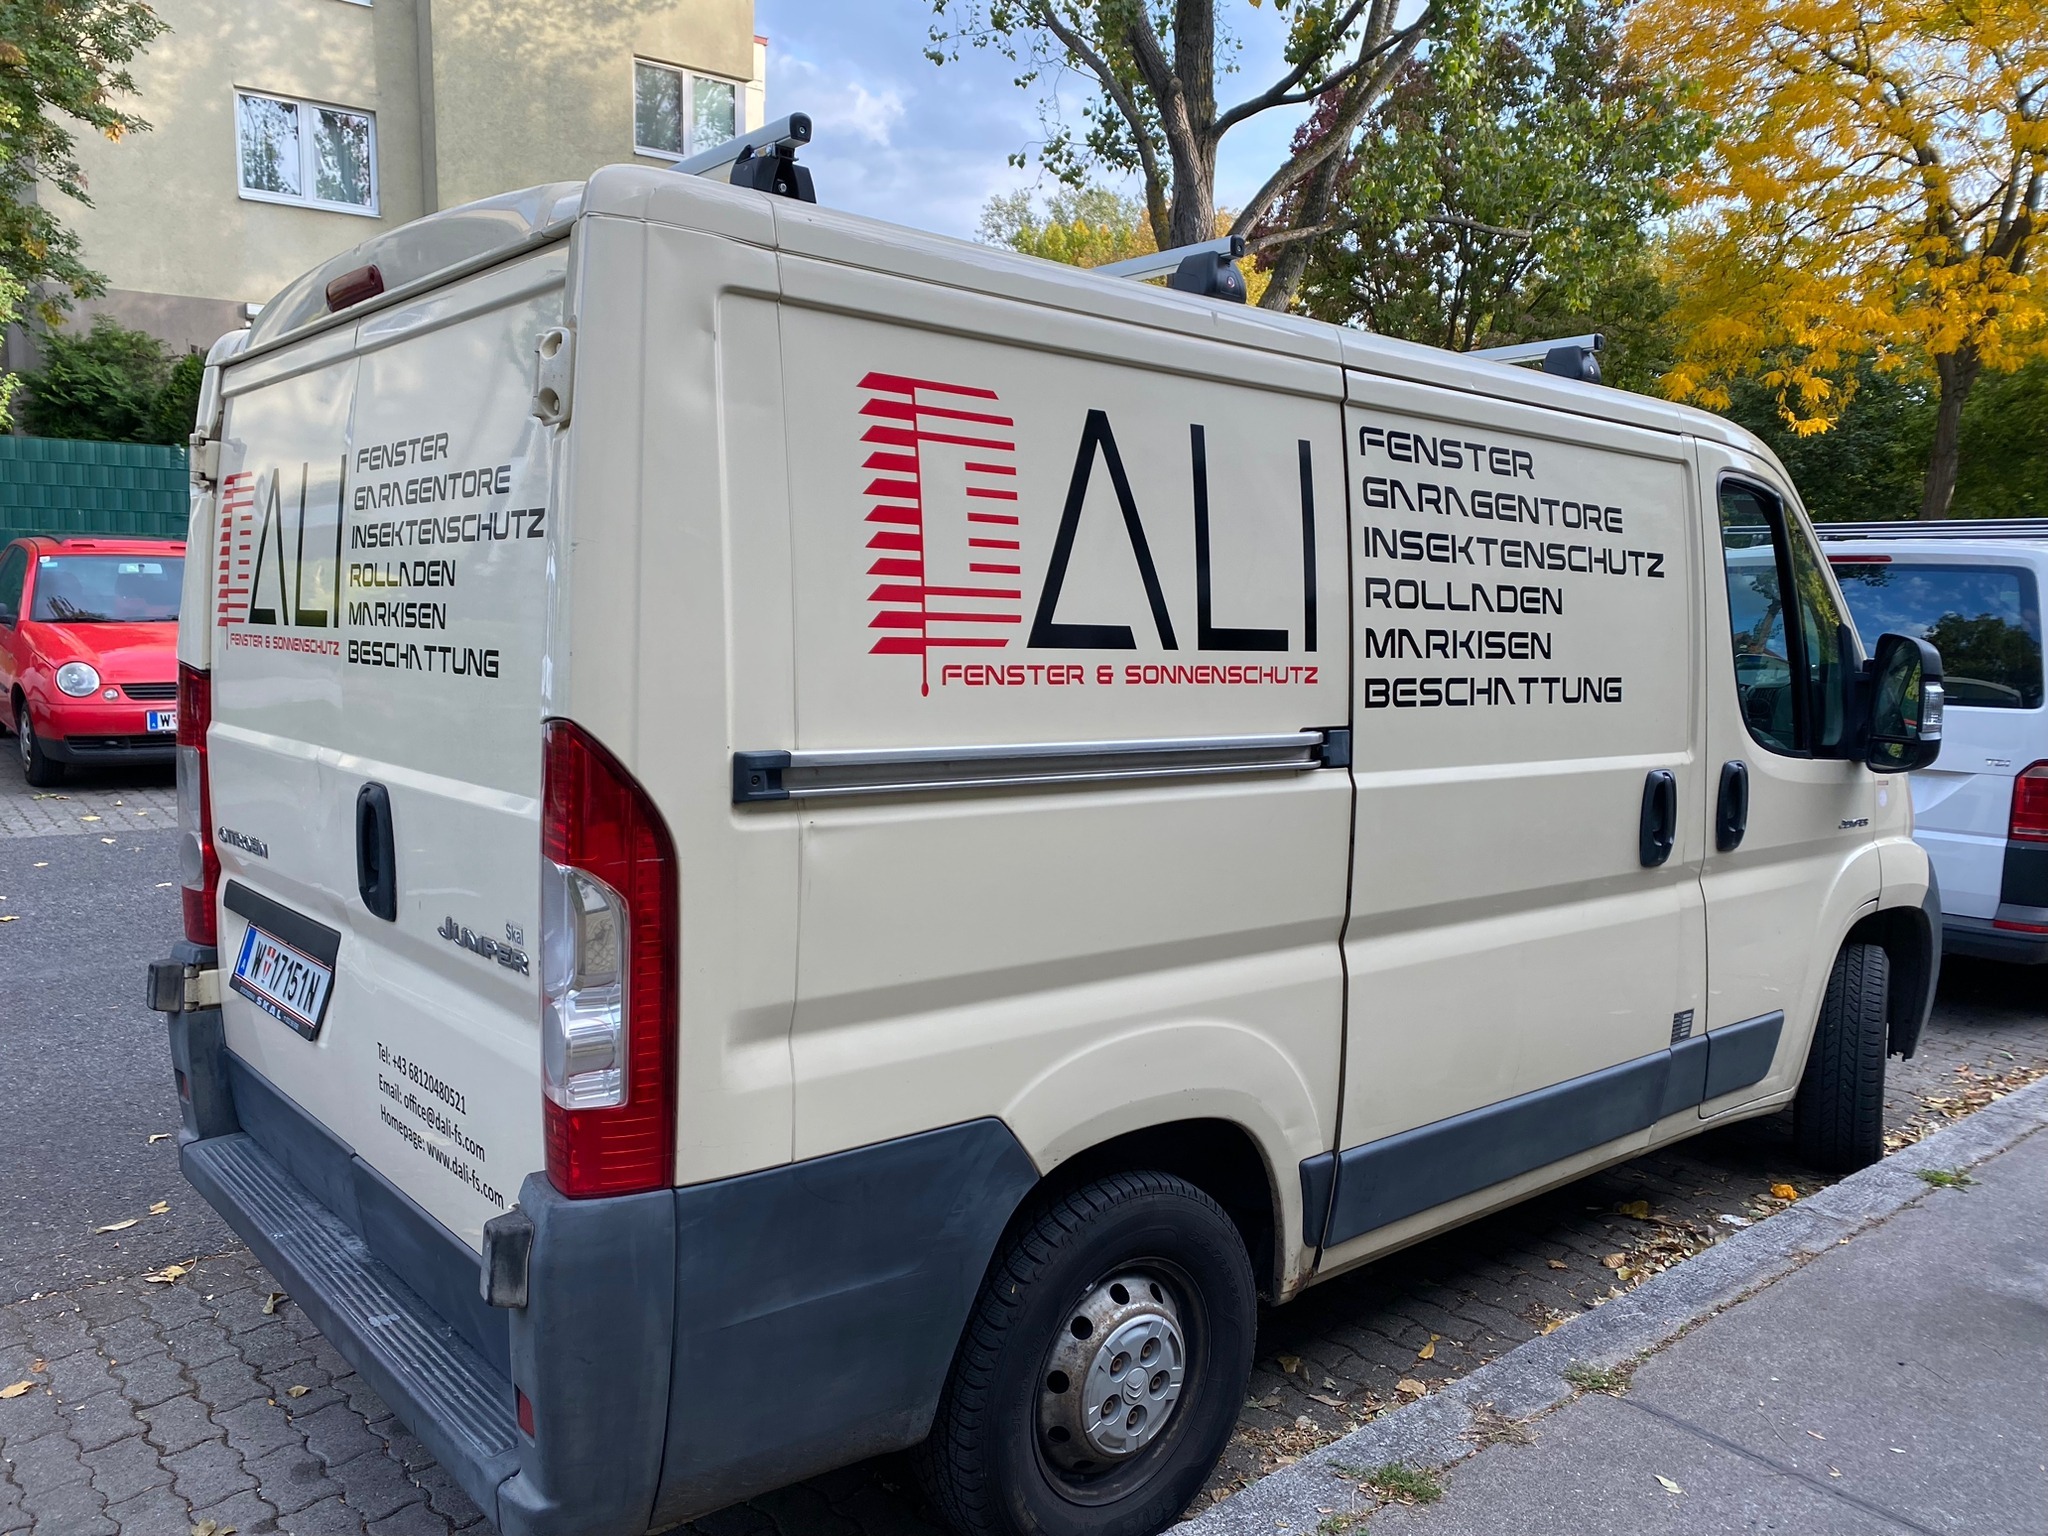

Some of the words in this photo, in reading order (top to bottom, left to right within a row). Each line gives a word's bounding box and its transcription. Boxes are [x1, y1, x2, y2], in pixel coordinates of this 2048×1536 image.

[356, 432, 449, 473] FENSTER
[1359, 426, 1536, 479] FENSTER
[354, 465, 511, 511] GARAGENTORE
[1362, 476, 1623, 534] GARAGENTORE
[351, 508, 546, 549] INSEKTENSCHUTZ
[856, 371, 1318, 656] DALI
[1363, 526, 1665, 578] INSEKTENSCHUTZ
[350, 560, 456, 587] ROLLADEN
[349, 602, 446, 630] MARKISEN
[1365, 577, 1563, 615] ROLLADEN
[230, 633, 262, 649] FENSTER
[265, 635, 271, 649] &
[273, 636, 340, 656] SONNENSCHUTZ
[348, 640, 499, 678] BESCHATTUNG
[1365, 627, 1552, 660] MARKISEN
[942, 665, 1085, 686] FENSTER
[1096, 665, 1114, 685] &
[1125, 665, 1319, 685] SONNENSCHUTZ
[1364, 677, 1622, 709] BESCHATTUNG
[437, 916, 530, 976] JUMPER
[505, 923, 524, 946] Skal
[255, 996, 282, 1020] SKAL
[377, 1041, 391, 1066] Tel:
[392, 1055, 407, 1076] +43
[408, 1062, 467, 1115] 68120480521
[378, 1073, 403, 1104] Email:
[403, 1093, 486, 1163] office@dali-fs.com
[380, 1104, 426, 1151] Homepage:
[426, 1141, 505, 1210] www.dali-fs.com
